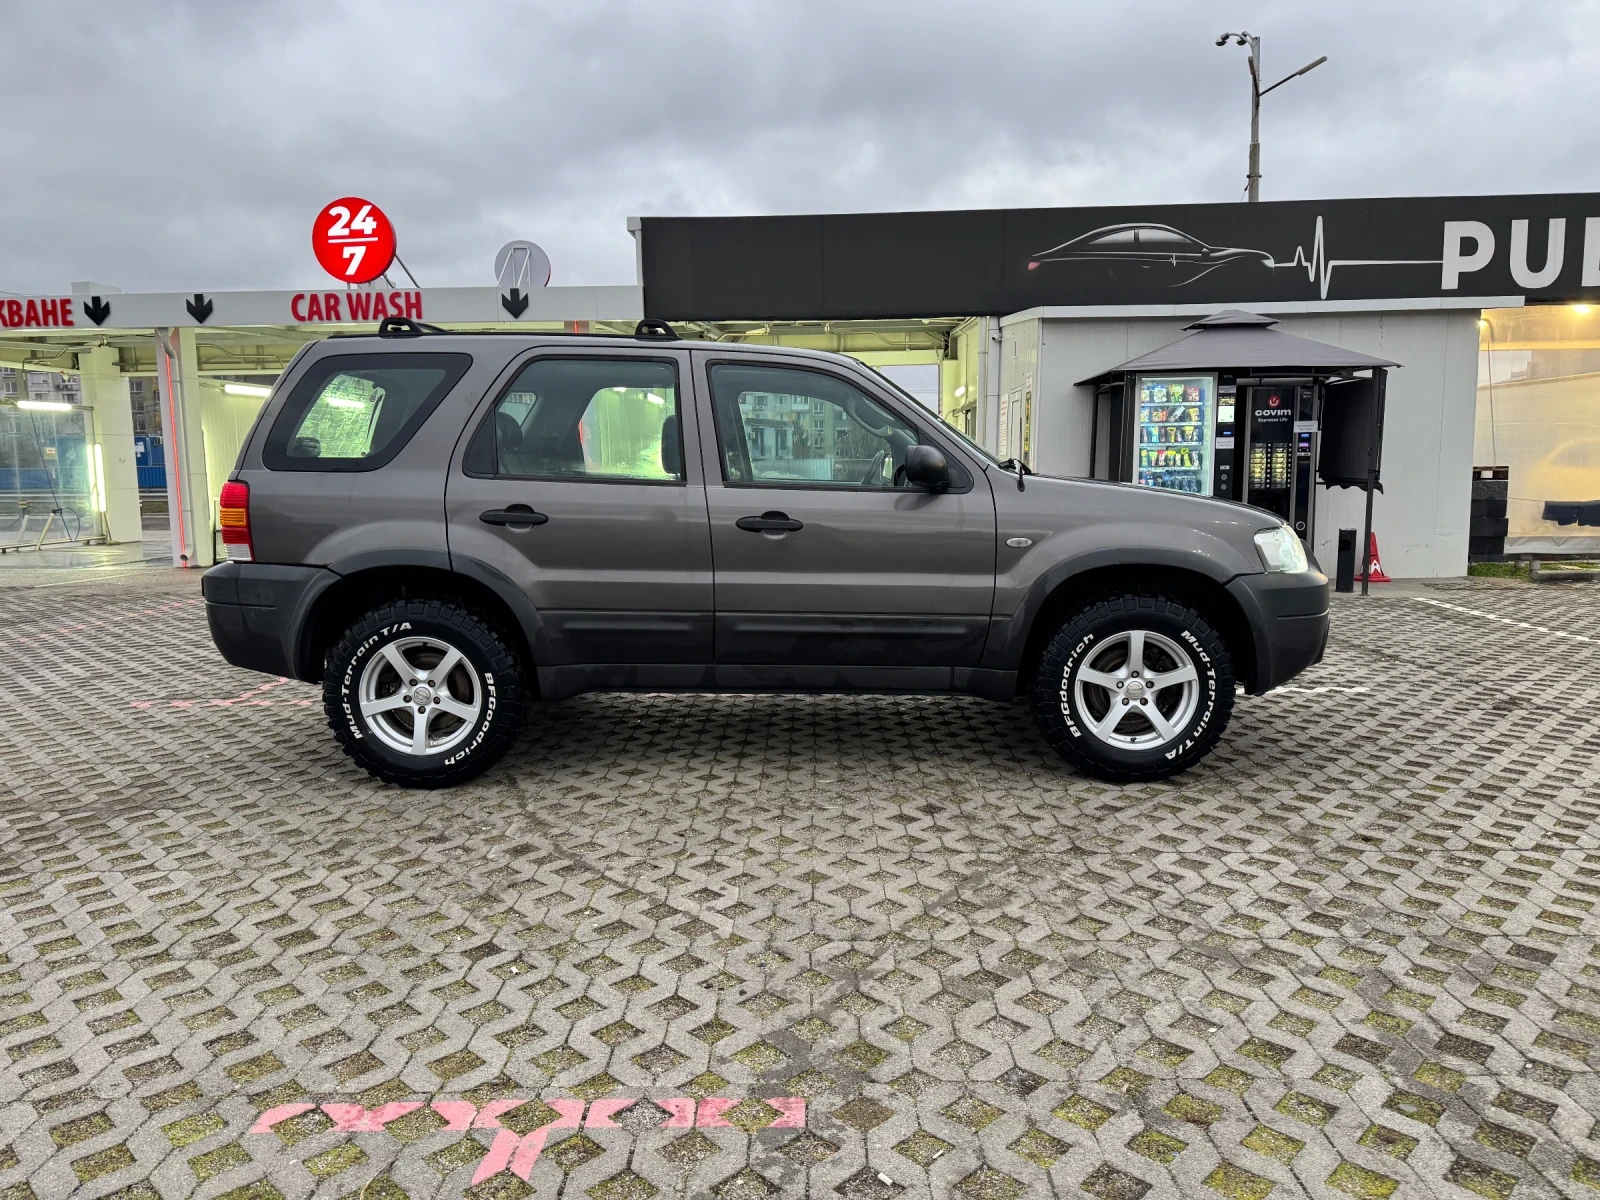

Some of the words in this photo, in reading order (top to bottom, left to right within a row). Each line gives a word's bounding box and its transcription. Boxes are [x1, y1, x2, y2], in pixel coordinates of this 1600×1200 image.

[328, 205, 377, 236] 24
[342, 246, 366, 275] 7
[291, 292, 341, 322] CAR
[346, 291, 422, 321] WASH
[341, 635, 379, 739] Mud-Terrain
[380, 622, 412, 636] T/A
[1059, 633, 1094, 738] BFGoodrich
[1181, 630, 1216, 738] Mud-Terrain
[445, 672, 497, 766] BFGoodrich
[1165, 739, 1195, 760] T/A
